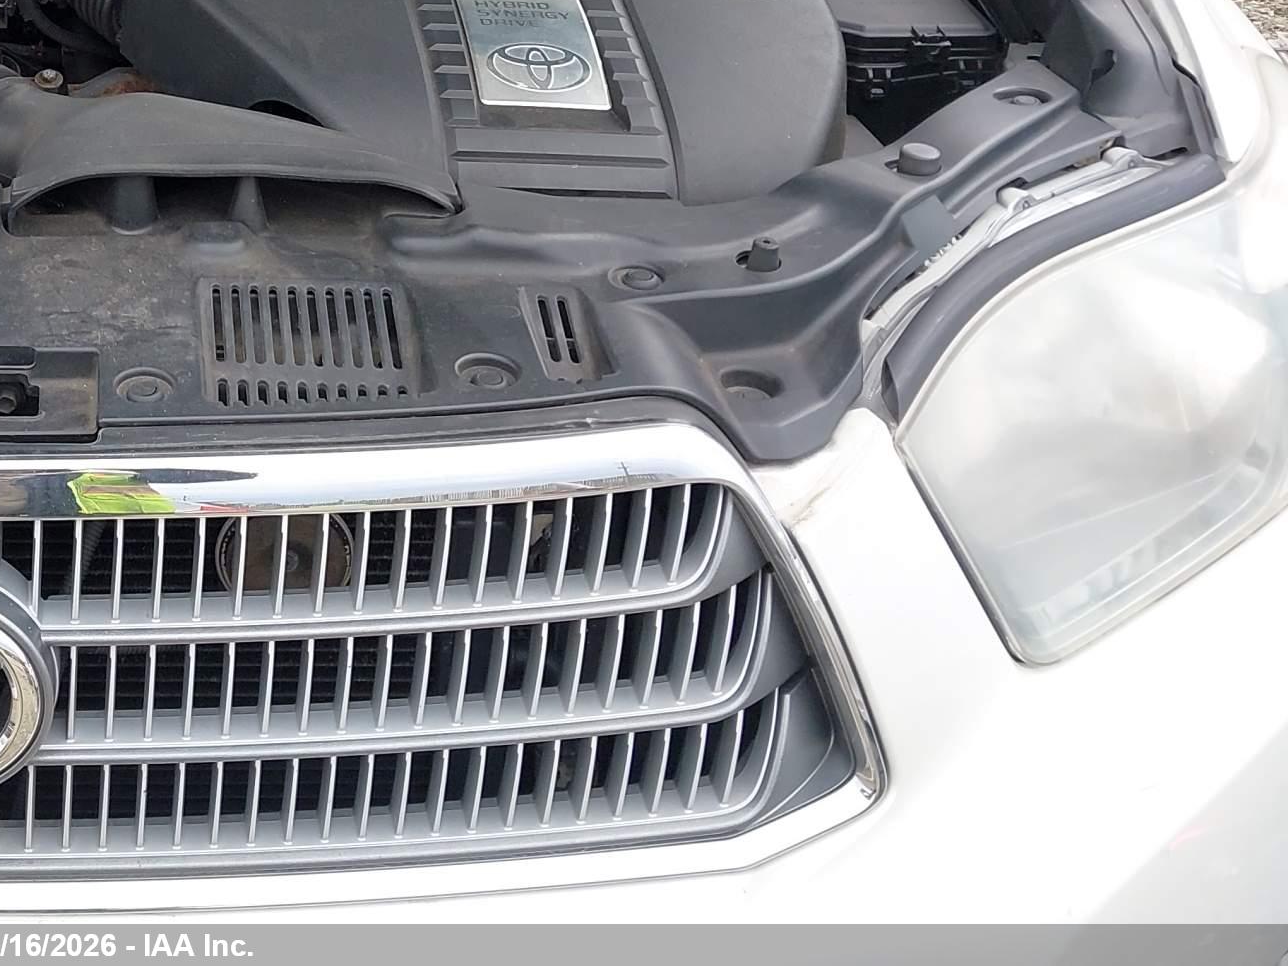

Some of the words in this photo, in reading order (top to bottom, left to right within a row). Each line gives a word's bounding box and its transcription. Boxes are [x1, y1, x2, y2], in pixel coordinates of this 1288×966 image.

[473, 0, 550, 10] HYBRID
[476, 9, 569, 20] SYNERGY
[479, 18, 541, 28] DRIVE
